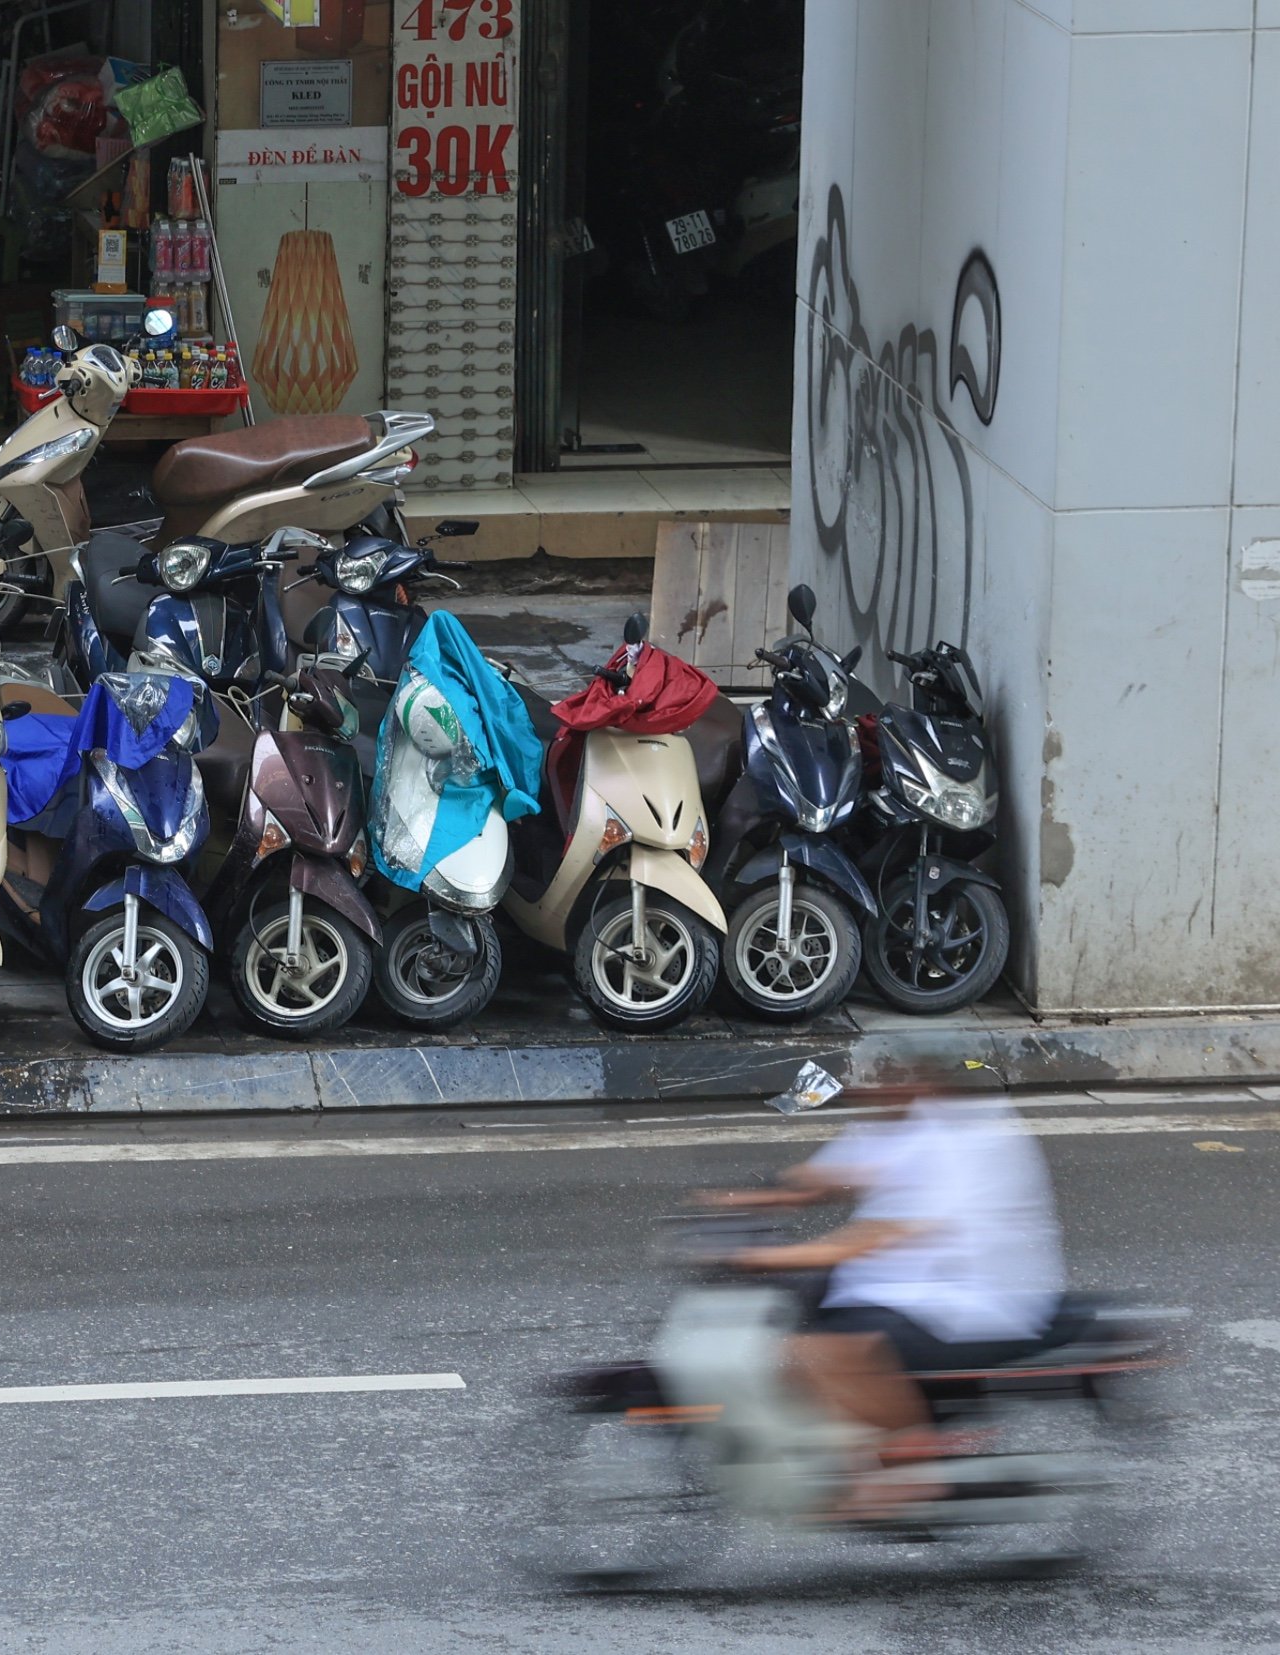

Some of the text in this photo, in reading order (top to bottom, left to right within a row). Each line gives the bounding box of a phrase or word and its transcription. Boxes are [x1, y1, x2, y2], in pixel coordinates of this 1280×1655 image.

[401, 0, 513, 41] 473
[292, 91, 322, 100] KLED
[397, 53, 453, 118] GỘI
[248, 142, 362, 166] ĐÈN ĐỂ BÀN
[397, 124, 515, 197] 30K
[671, 213, 704, 236] 29-T1
